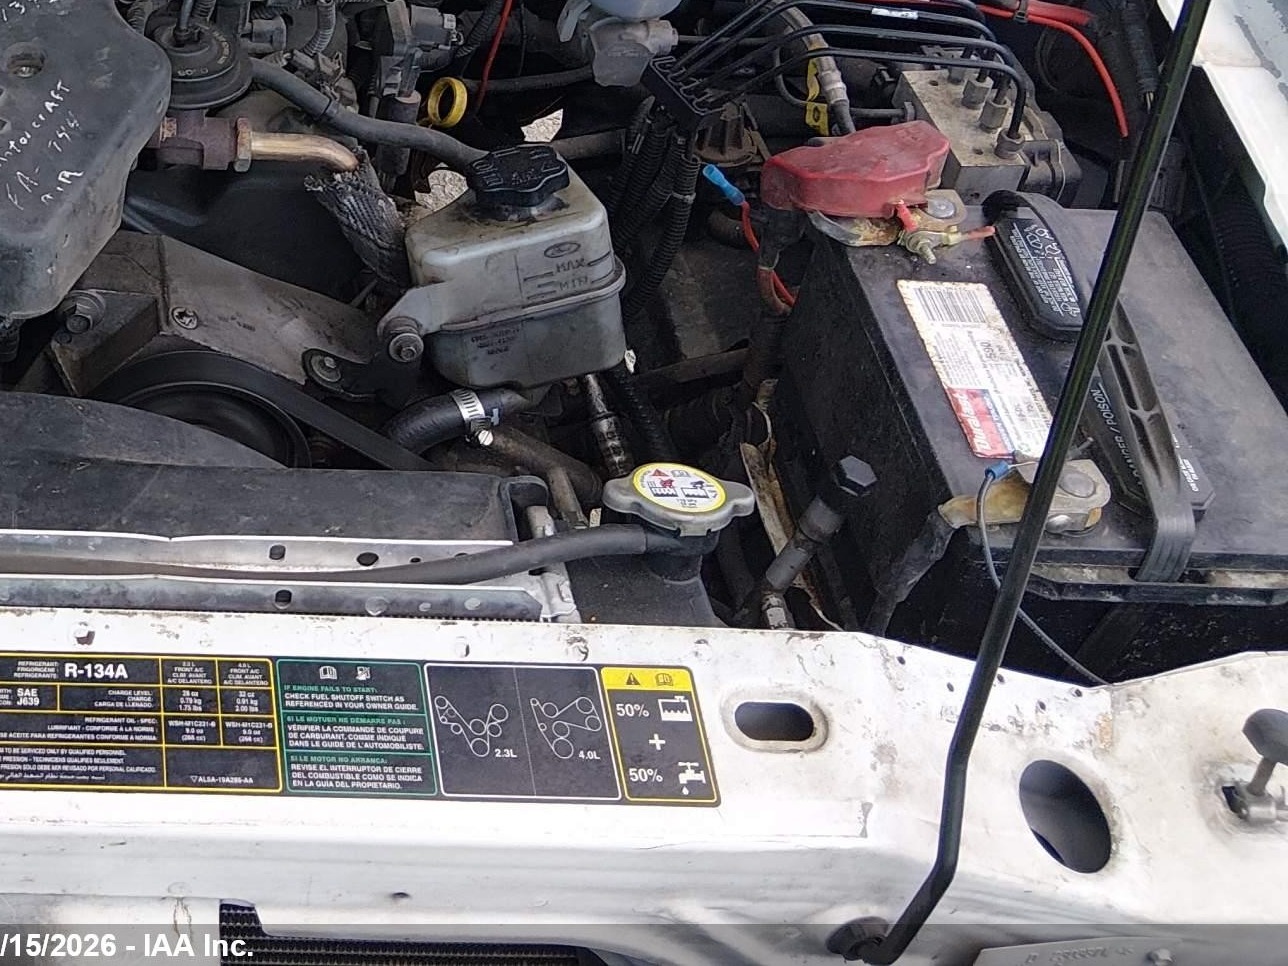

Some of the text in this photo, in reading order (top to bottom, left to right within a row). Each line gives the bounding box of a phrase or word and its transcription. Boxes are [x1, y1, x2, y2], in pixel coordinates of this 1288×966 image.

[1090, 388, 1118, 426] POISON
[952, 391, 992, 452] Duralast
[64, 663, 129, 679] R-134A
[17, 688, 38, 697] SAE
[17, 697, 39, 706] J639
[331, 694, 364, 702] SHUTOFF
[285, 700, 335, 709] REFERENCED
[366, 702, 393, 710] OWNER
[394, 703, 419, 711] GUIDE.
[616, 704, 650, 717] 50%
[333, 725, 376, 733] COMMANDE
[388, 727, 424, 735] COUPURE
[300, 733, 347, 741] CARBURANT,
[494, 749, 517, 758] 2.3L
[578, 750, 601, 760] 4.0L
[291, 763, 318, 771] REVISE
[330, 765, 382, 773] INTERRUPTOR
[395, 766, 422, 774] CIERRE
[308, 772, 360, 780] COMBUSTIBLE
[398, 775, 423, 783] INDICA
[628, 768, 663, 783] 50%
[351, 782, 403, 790] PROPIETARIO.
